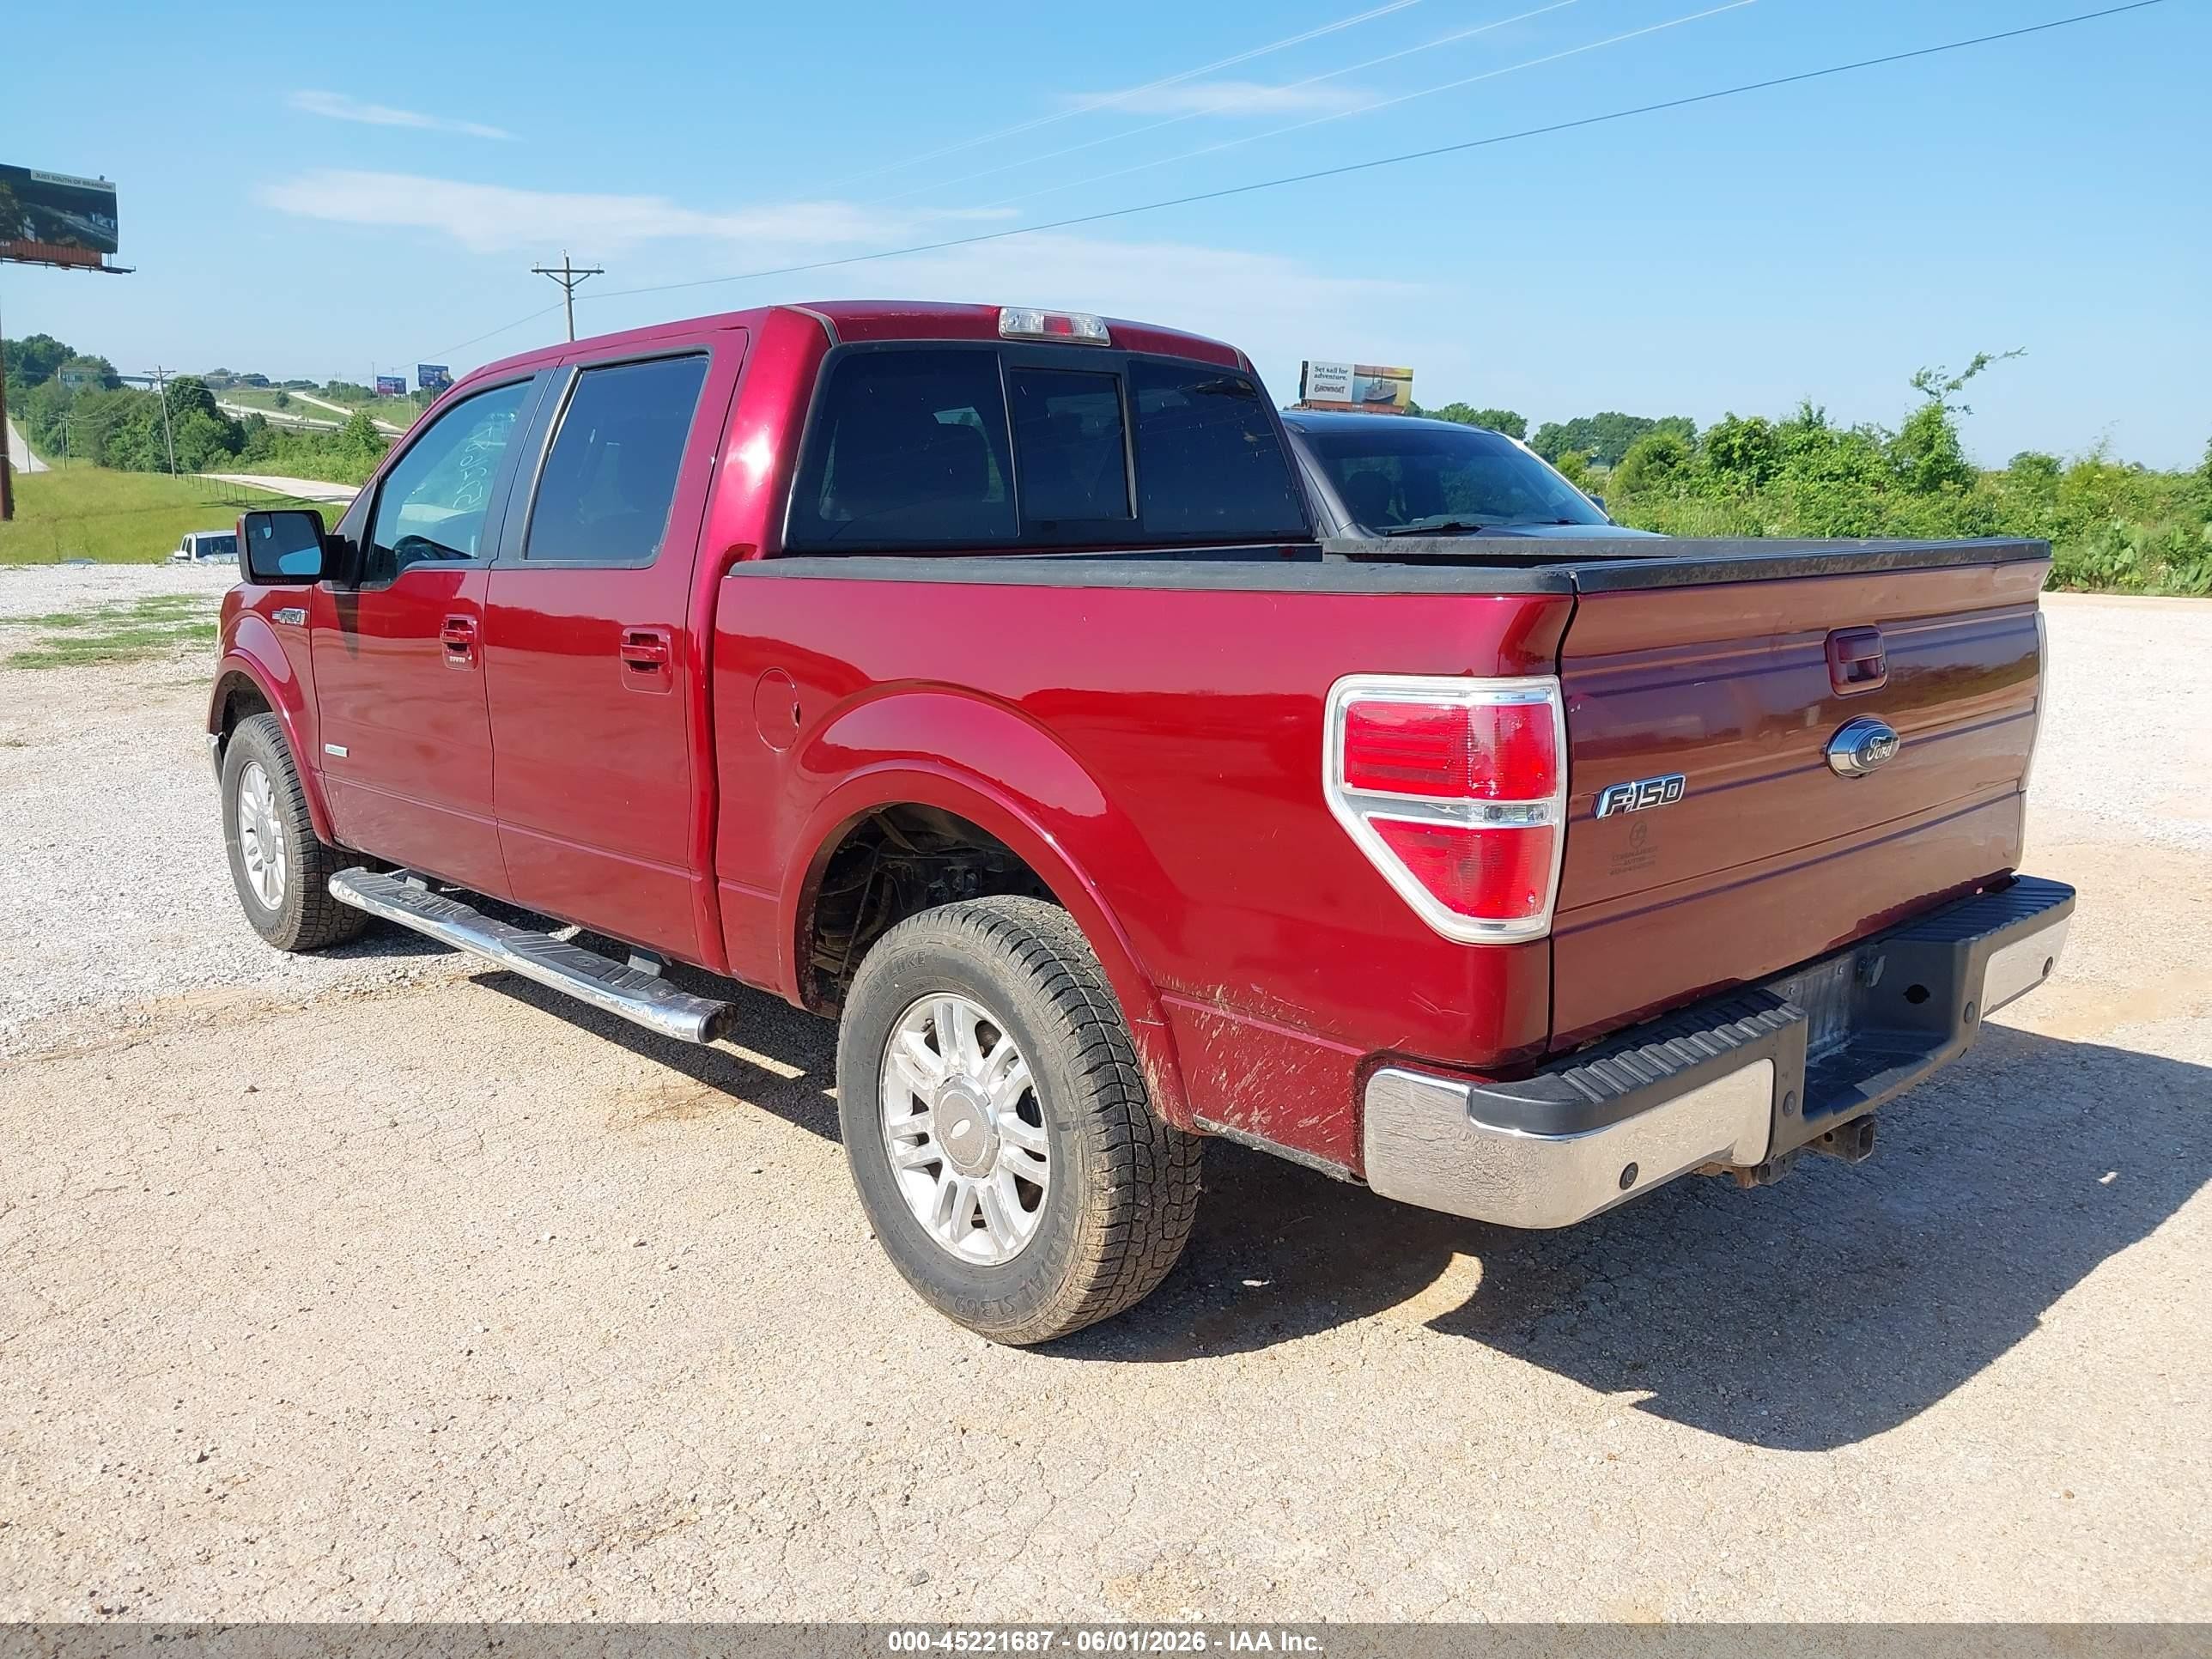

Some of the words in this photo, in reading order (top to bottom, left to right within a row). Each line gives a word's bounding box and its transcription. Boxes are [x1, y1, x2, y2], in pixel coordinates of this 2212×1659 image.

[52, 175, 72, 184] SOUTH
[1314, 373, 1348, 381] adventure.
[1866, 735, 1894, 762] Ford
